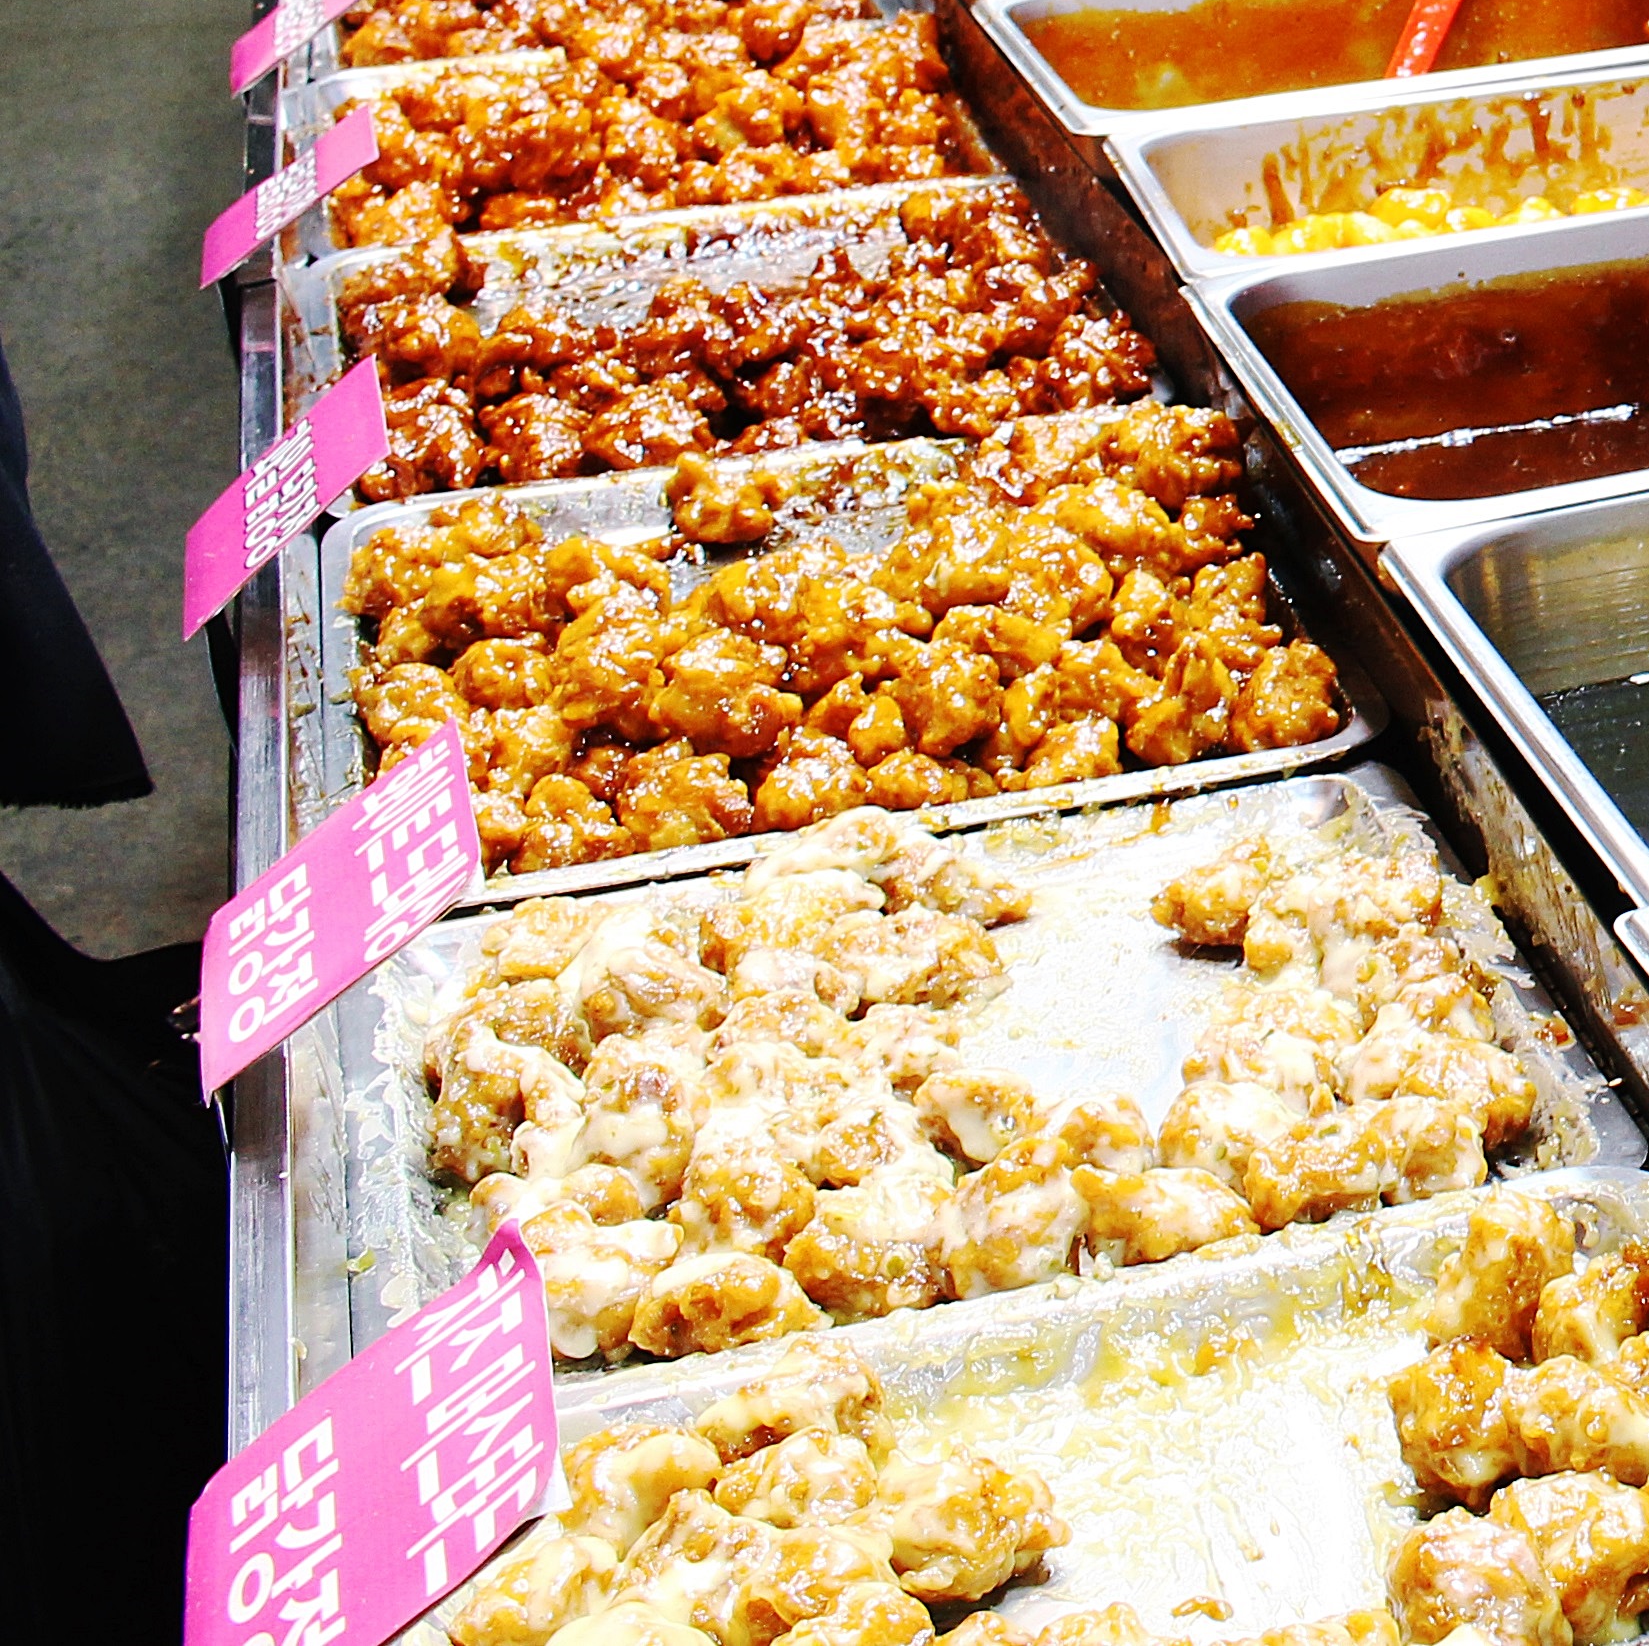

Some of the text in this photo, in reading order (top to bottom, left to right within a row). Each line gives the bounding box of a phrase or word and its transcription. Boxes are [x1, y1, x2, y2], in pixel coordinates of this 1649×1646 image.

[244, 453, 320, 572] 닭강정
[352, 739, 457, 873] 화이트
[228, 862, 319, 1045] 닭강정
[395, 1247, 526, 1407] 치즈
[227, 1414, 347, 1646] 닭강정
